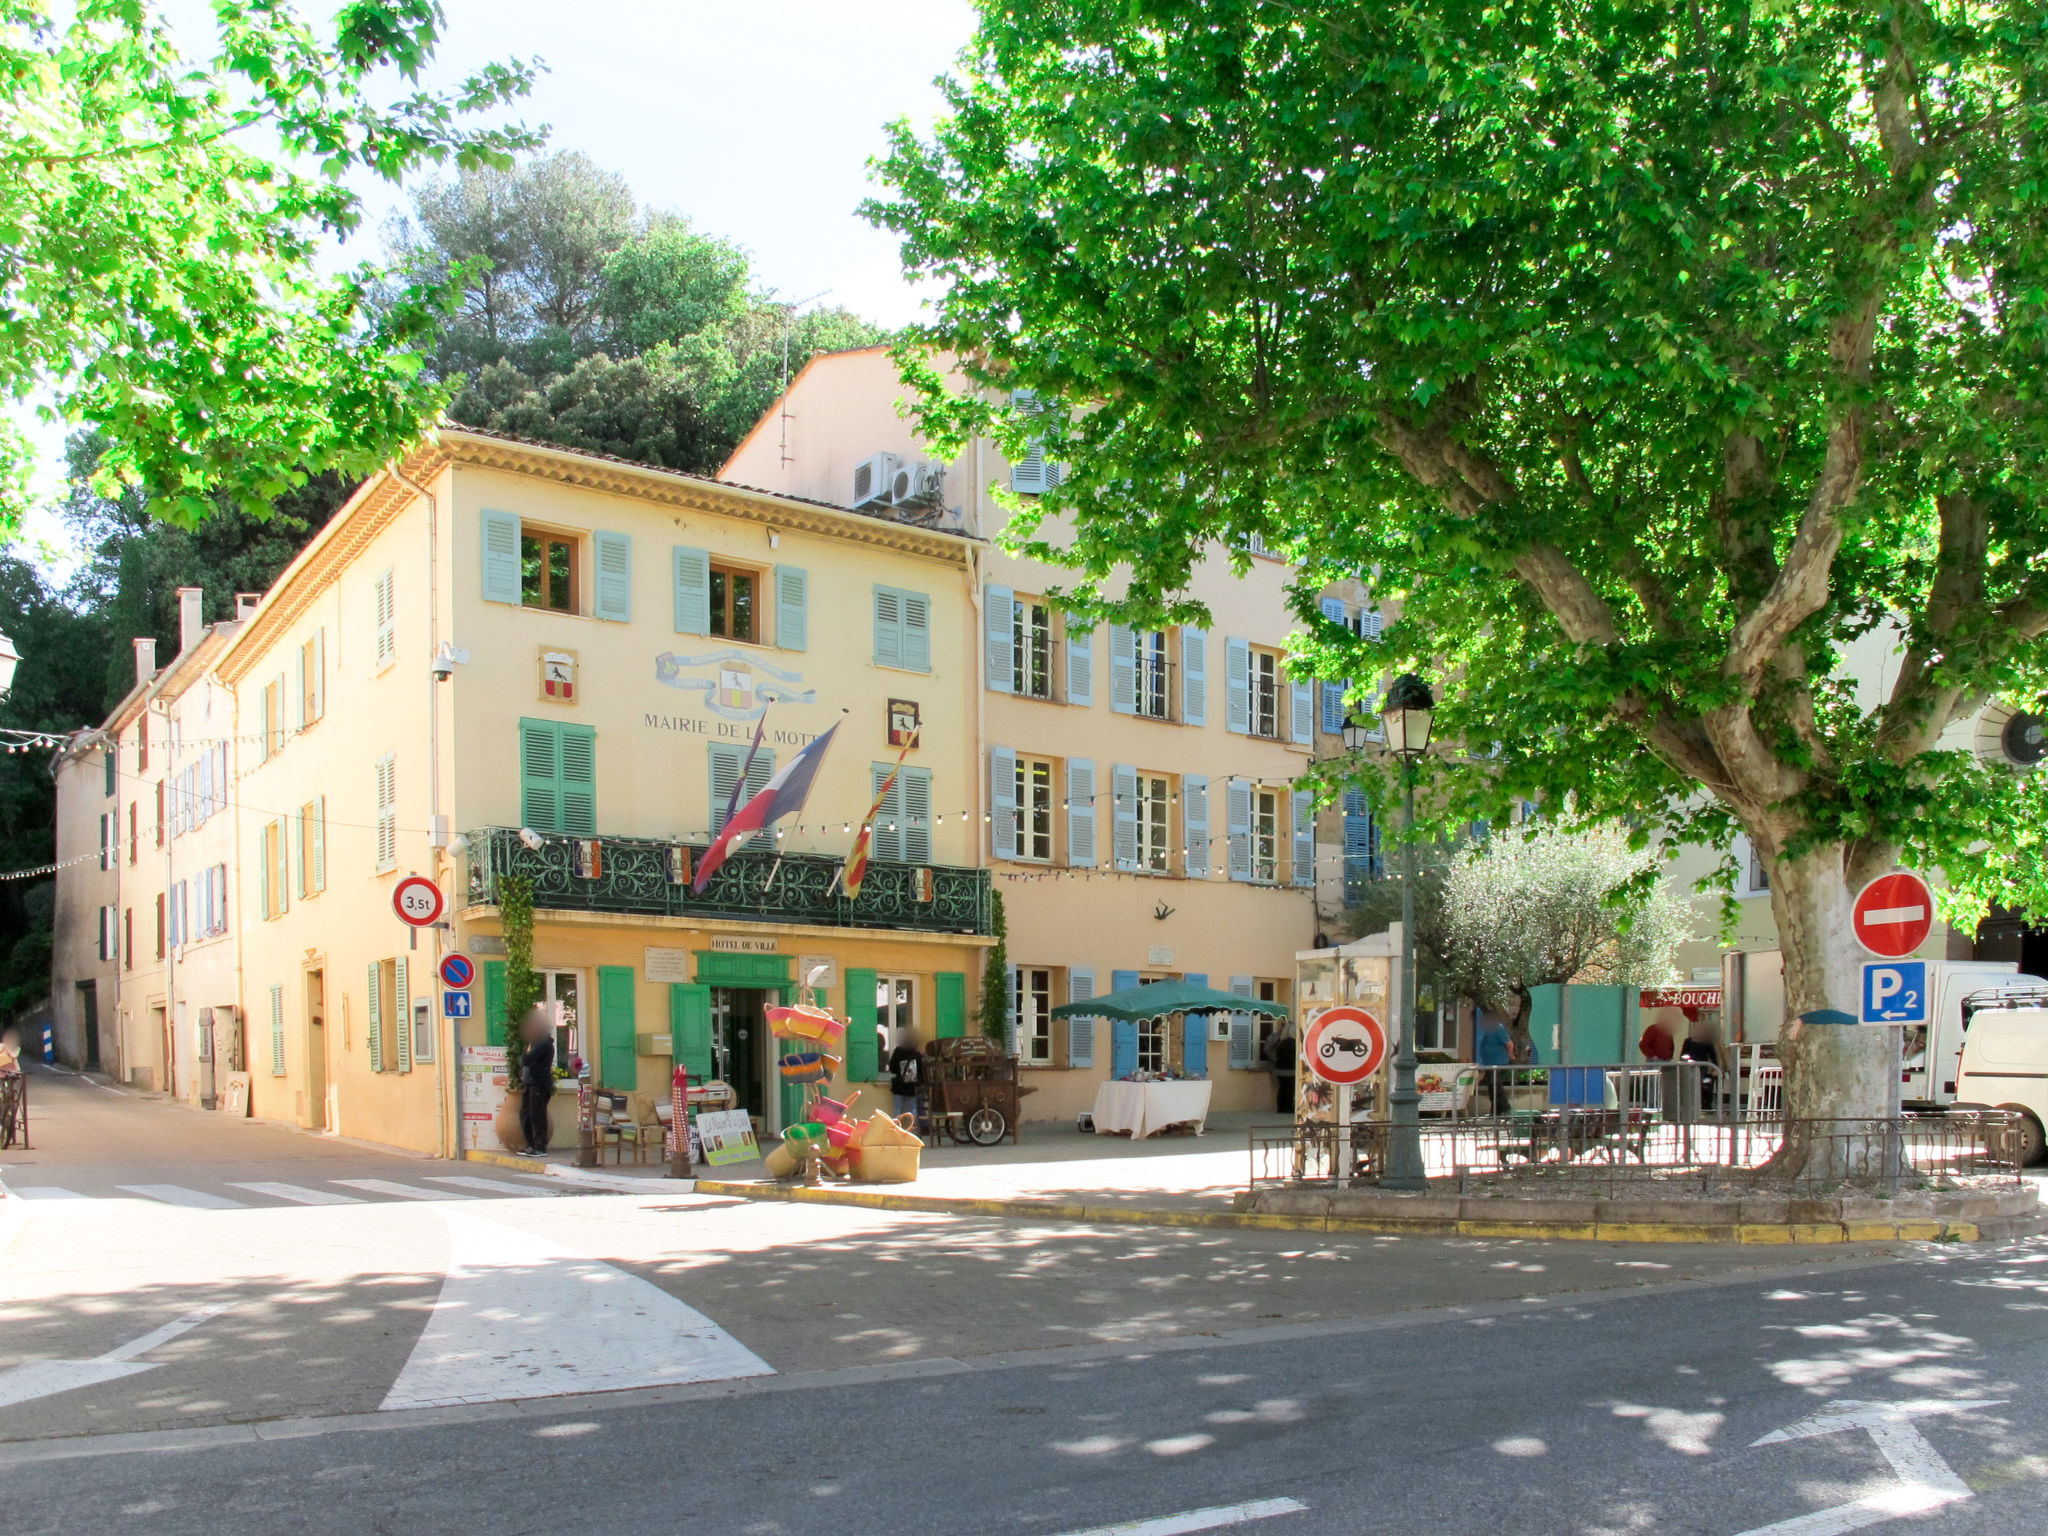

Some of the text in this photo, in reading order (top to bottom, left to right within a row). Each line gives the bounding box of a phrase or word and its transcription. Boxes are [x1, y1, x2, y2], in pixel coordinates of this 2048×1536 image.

[644, 713, 709, 734] MAIRIE
[717, 722, 740, 738] DE
[746, 726, 767, 742] LA
[711, 939, 777, 951] HOTEL DE VILLE
[1872, 968, 1918, 1010] P 2
